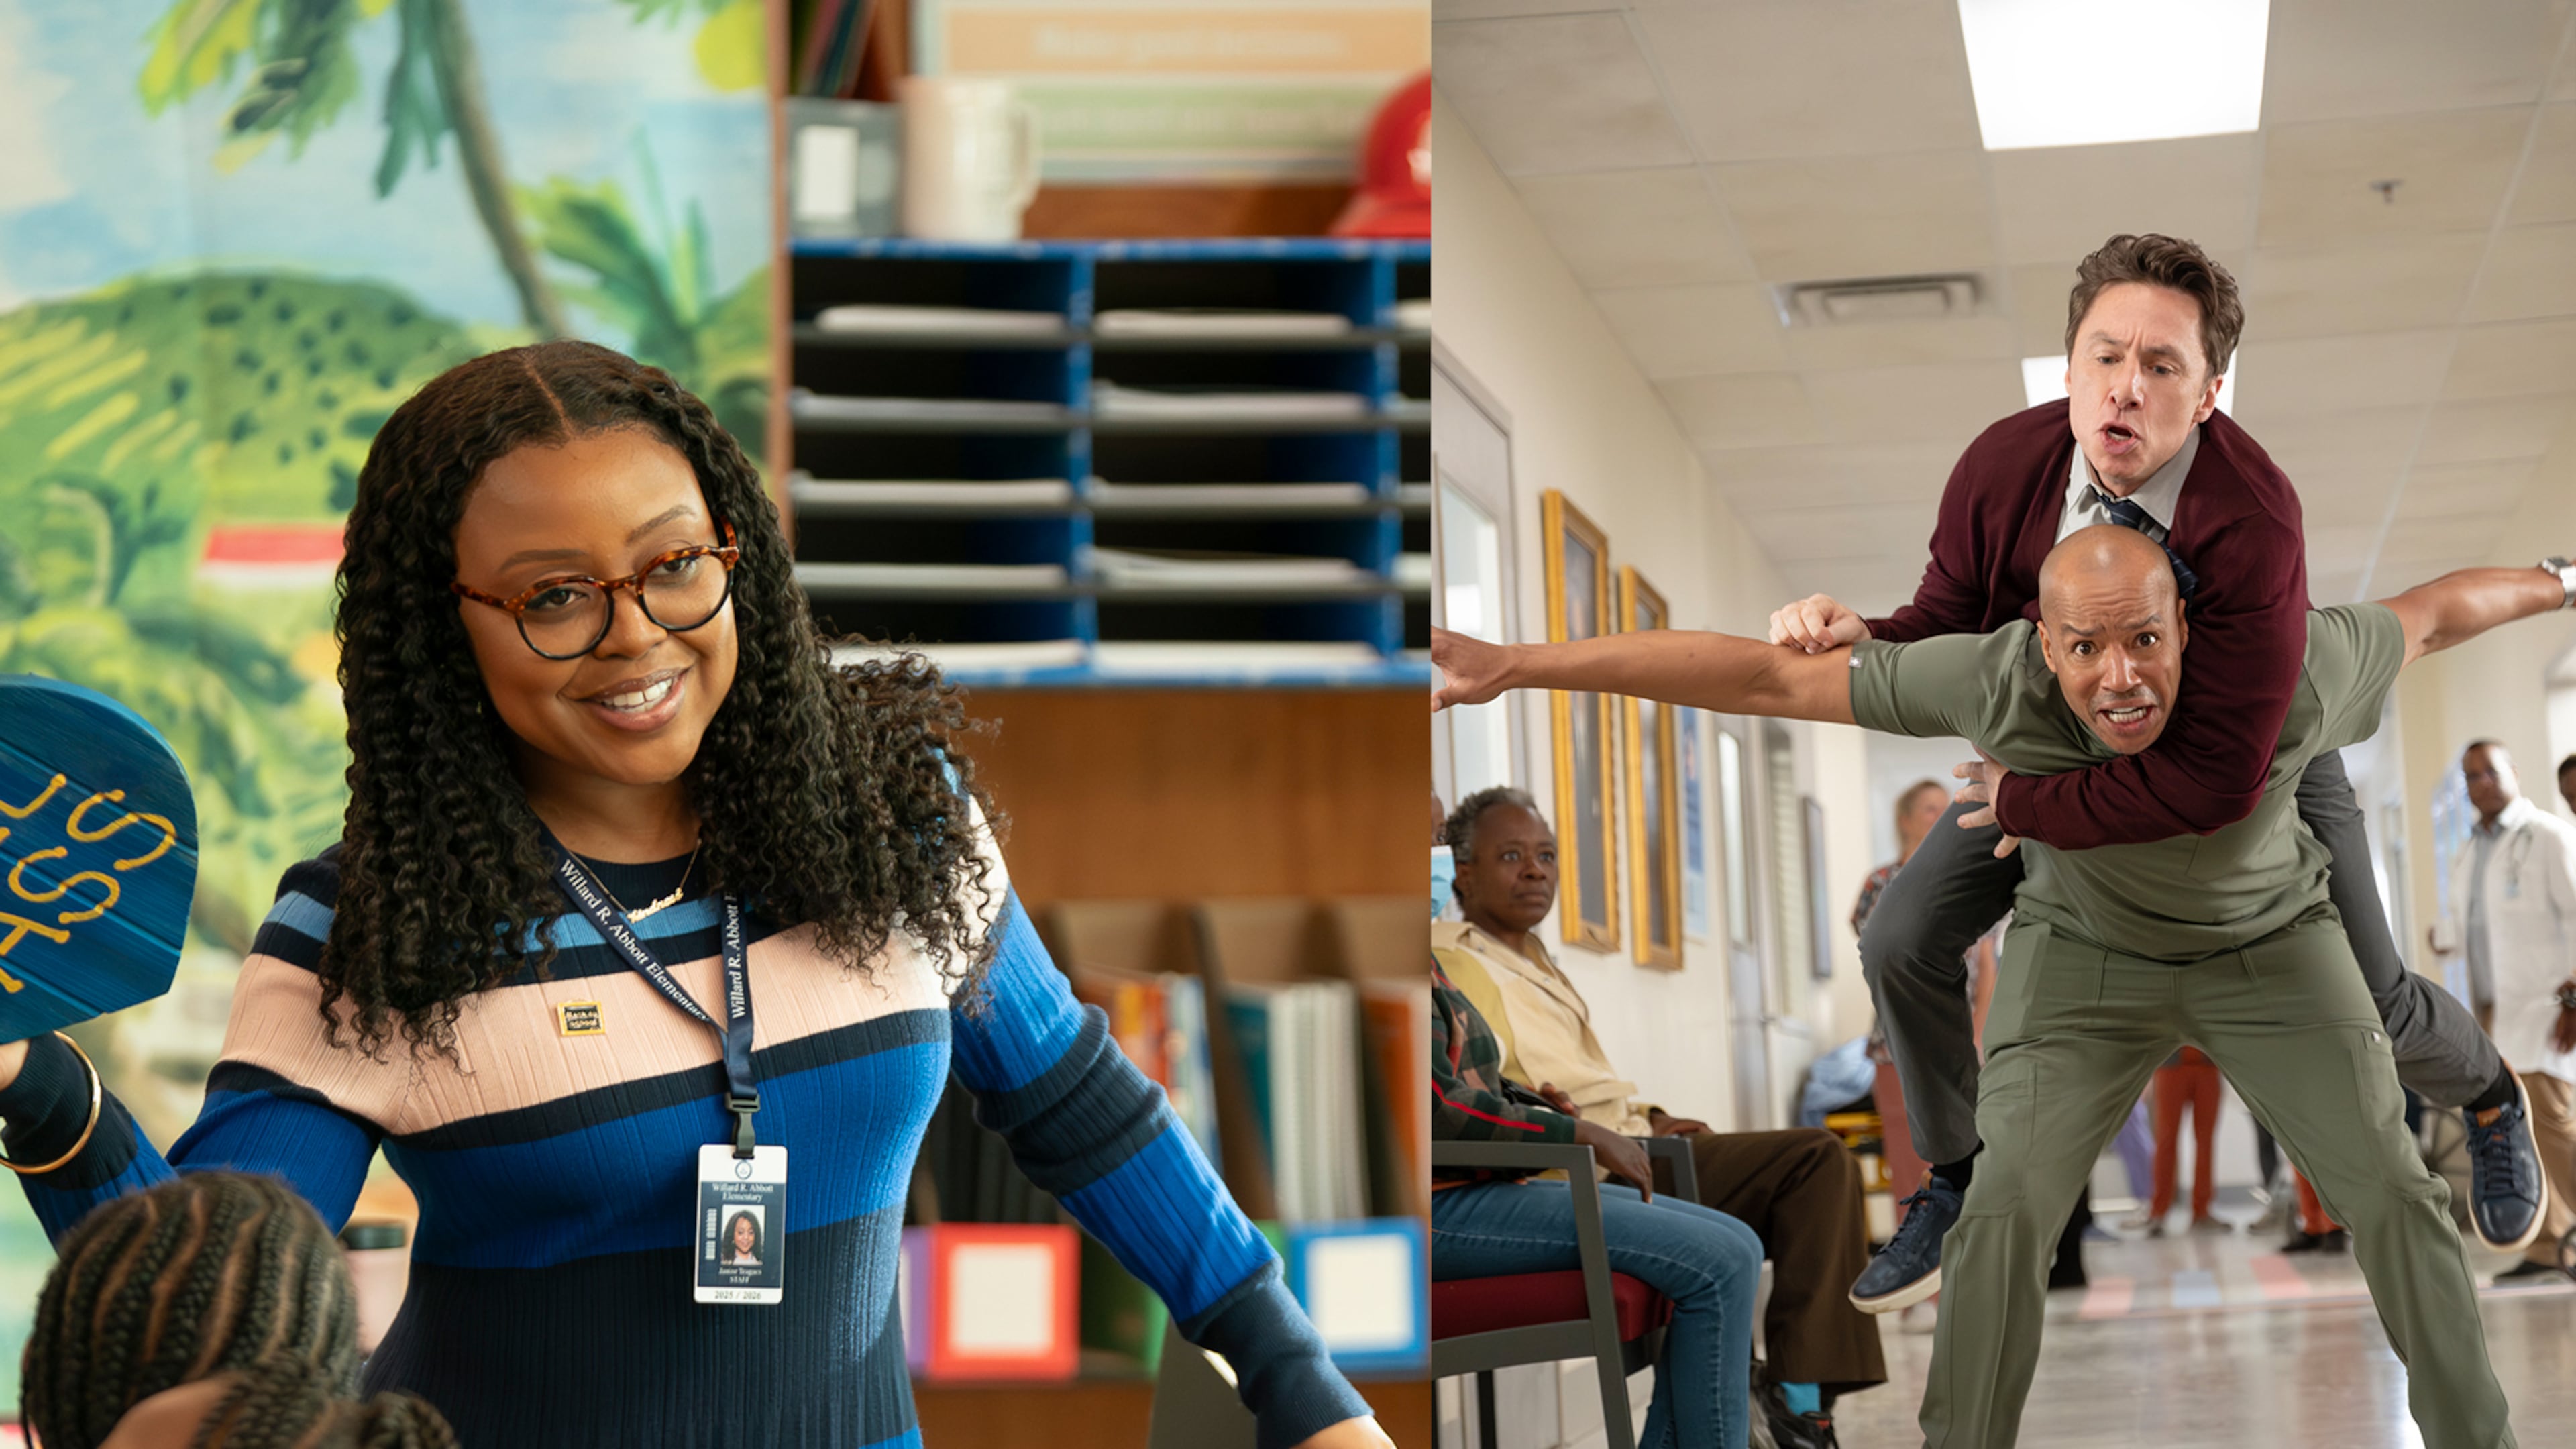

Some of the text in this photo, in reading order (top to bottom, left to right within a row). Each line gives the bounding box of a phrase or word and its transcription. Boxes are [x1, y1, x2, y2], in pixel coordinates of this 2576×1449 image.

[561, 859, 602, 909] Willard
[596, 906, 612, 925] R.
[608, 924, 649, 964] Abbott
[726, 905, 741, 951] Abbott
[728, 954, 741, 968] R.
[729, 971, 745, 1019] Willard
[712, 1183, 773, 1193] Willard R. Abbott
[722, 1192, 763, 1203] Elementary
[714, 1290, 733, 1299] 2025
[743, 1291, 761, 1300] 2026
